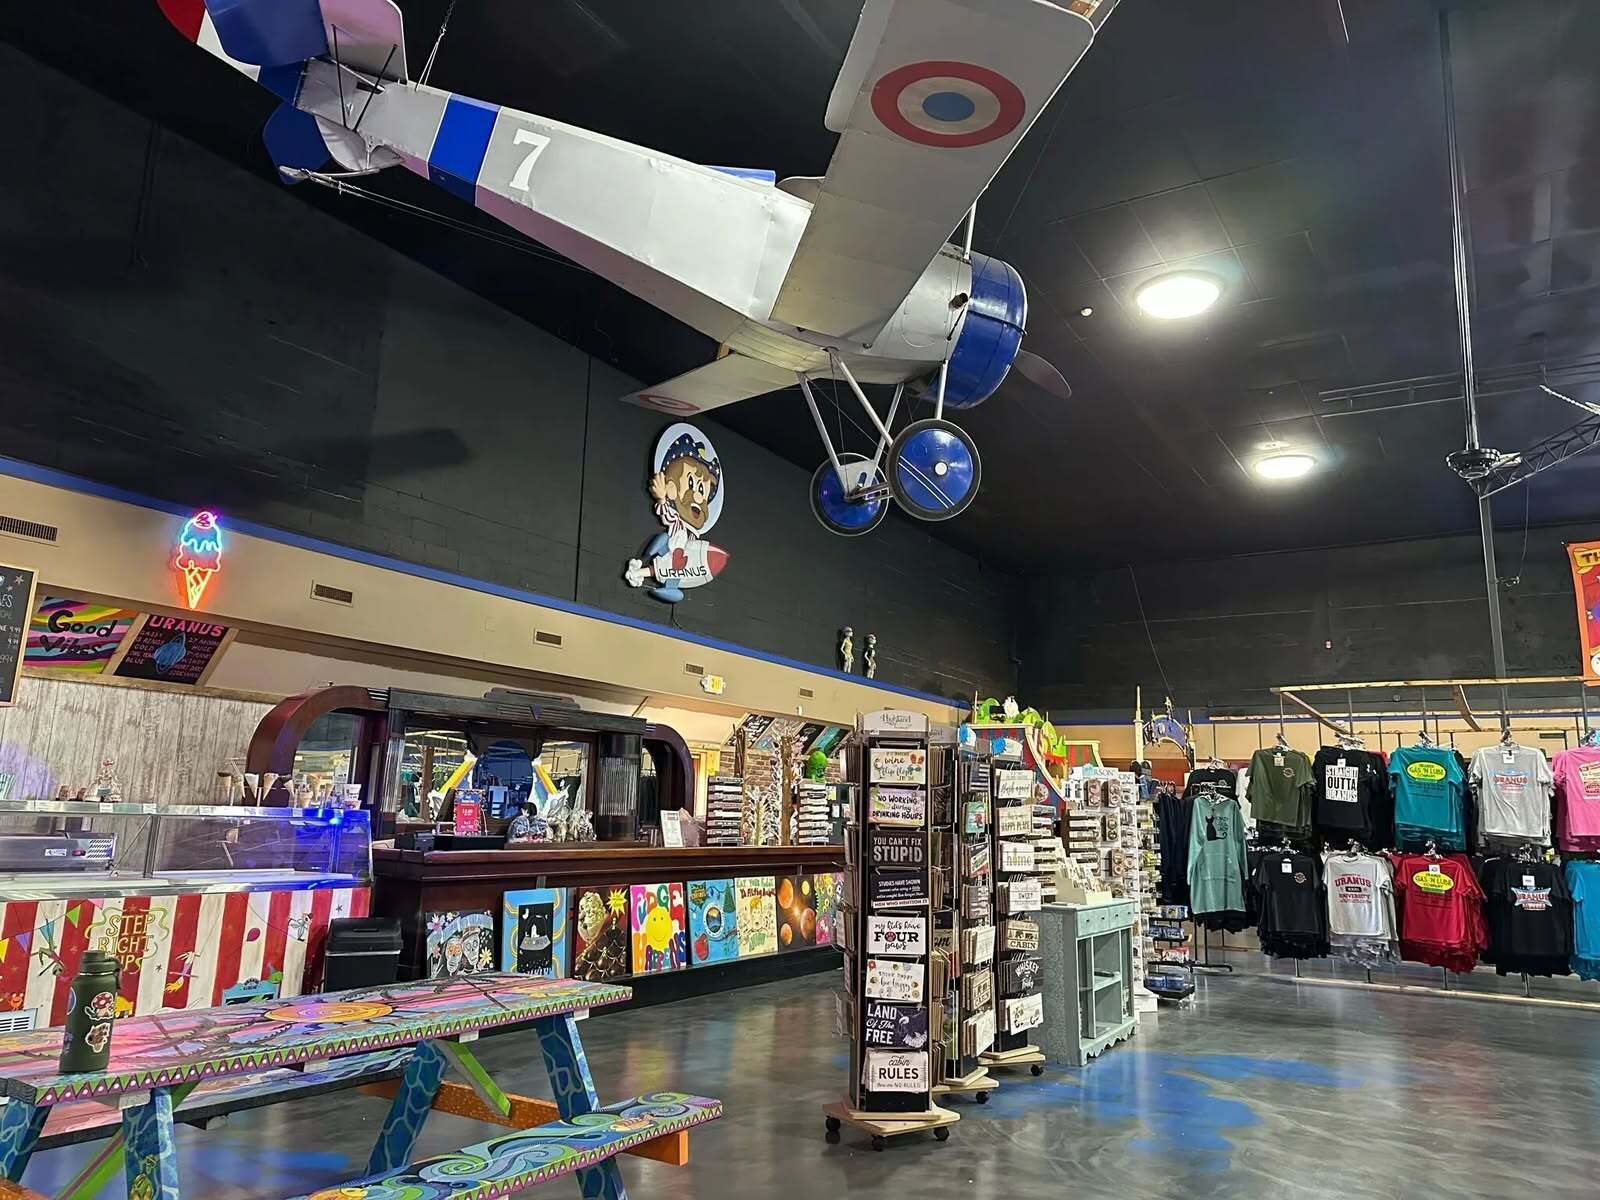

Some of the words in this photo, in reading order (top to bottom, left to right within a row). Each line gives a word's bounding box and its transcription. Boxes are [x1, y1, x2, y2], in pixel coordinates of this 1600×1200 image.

[509, 128, 551, 192] 7
[1582, 552, 1600, 563] TH
[659, 565, 707, 577] URANUS
[49, 609, 118, 638] Good
[149, 615, 225, 637] URANUS
[1328, 777, 1356, 790] OUTTA
[1493, 776, 1528, 784] URANUS
[889, 795, 918, 804] WORKING
[872, 810, 900, 818] DRINKING
[902, 811, 923, 820] HOURS
[873, 837, 887, 845] YOU
[889, 837, 909, 845] CAN'T
[911, 838, 922, 846] FIX
[873, 845, 923, 862] STUPID
[1334, 876, 1372, 888] URANUS
[106, 914, 156, 937] STEP
[875, 924, 886, 933] my
[905, 921, 921, 929] have
[874, 931, 919, 943] FOUR
[98, 935, 155, 954] RIGHT
[885, 941, 908, 952] paws
[1010, 940, 1037, 949] CABIN
[632, 931, 687, 973] HAPPENS
[1015, 960, 1040, 977] WHISKEY
[867, 1003, 897, 1020] LAND
[866, 1018, 879, 1029] Of
[879, 1019, 895, 1030] The
[866, 1028, 894, 1045] FREE
[888, 1055, 911, 1067] cabin
[879, 1067, 919, 1080] RULES
